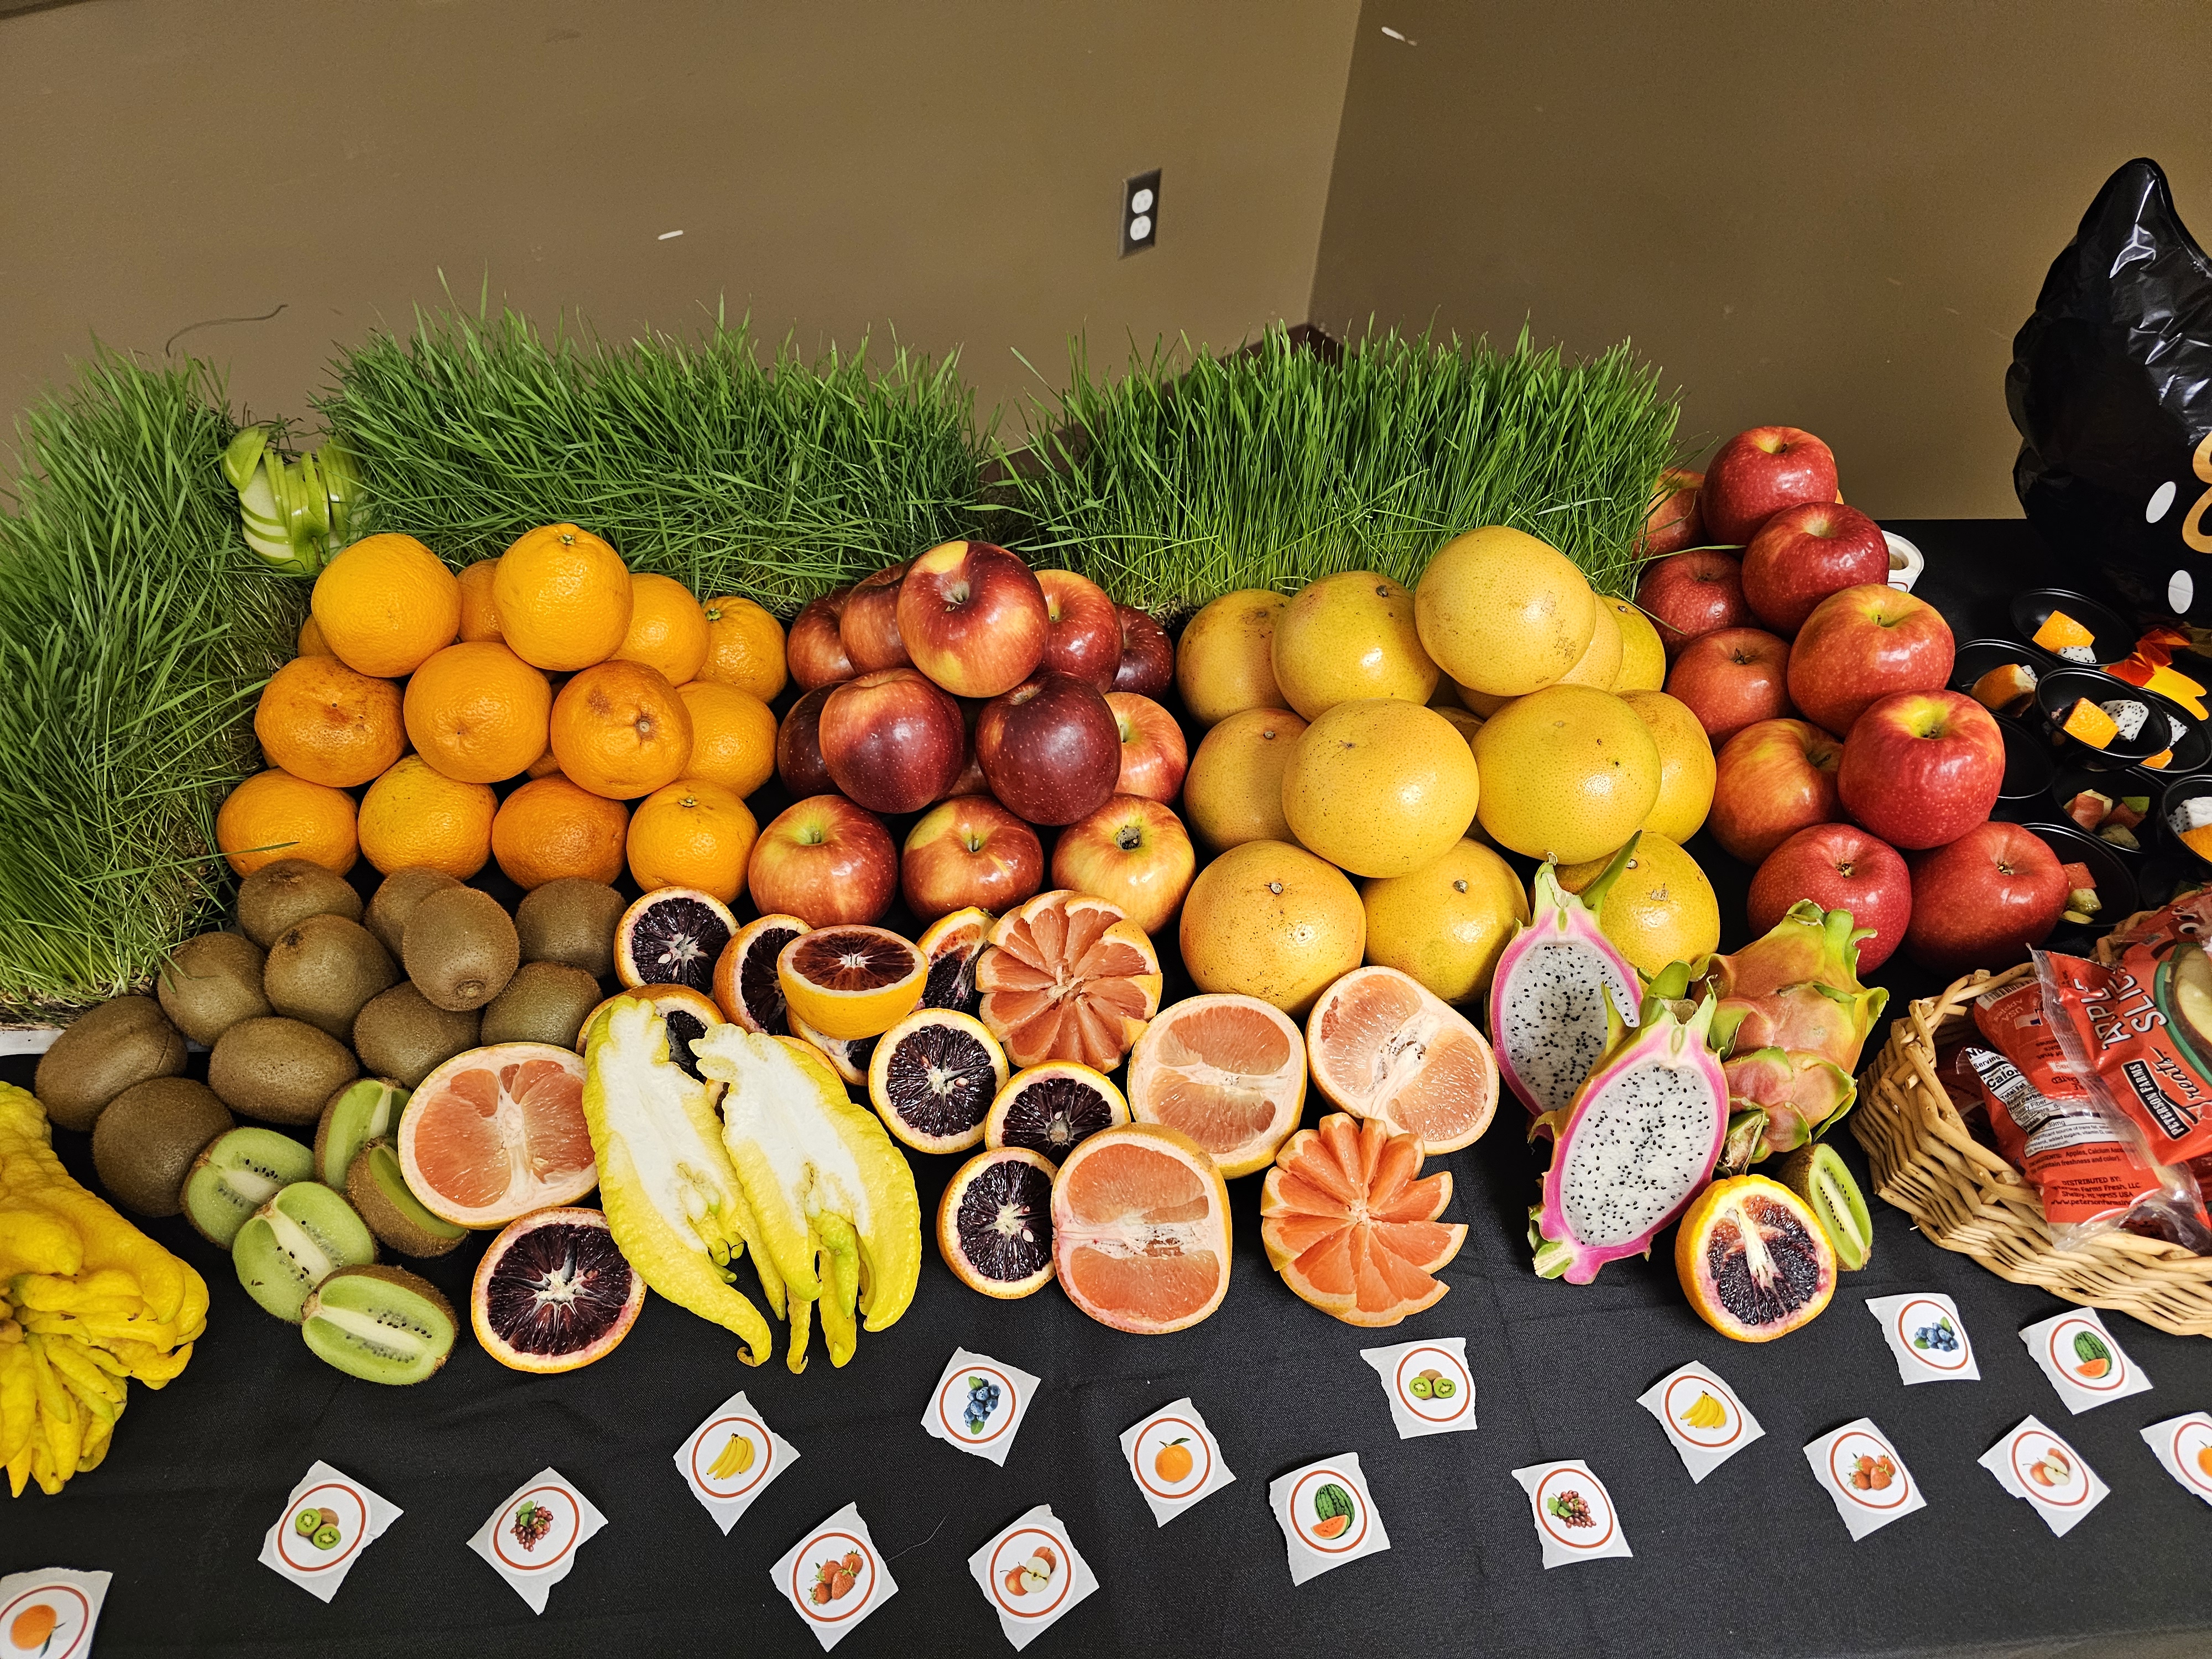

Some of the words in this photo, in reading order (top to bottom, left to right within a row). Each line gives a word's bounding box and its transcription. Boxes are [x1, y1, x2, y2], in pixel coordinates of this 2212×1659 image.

[2107, 968, 2169, 1032] SLIC
[1993, 997, 2023, 1022] Apples
[2001, 1006, 2024, 1021] USA
[1973, 1056, 2001, 1070] Serving
[1983, 1067, 2002, 1081] Amount
[2129, 1064, 2154, 1093] FARMS
[2000, 1088, 2016, 1100] Total
[2015, 1082, 2027, 1092] Fat
[2006, 1092, 2025, 1106] Sodium
[2015, 1105, 2030, 1117] Dietary
[2030, 1099, 2047, 1108] Fiber
[2027, 1107, 2049, 1117] Sugars
[2146, 1093, 2185, 1136] PETERSON
[2023, 1117, 2041, 1131] Protein
[2044, 1140, 2070, 1149] potassium.
[2065, 1150, 2088, 1158] Apples,
[2037, 1161, 2061, 1171] maintain
[2061, 1159, 2091, 1167] freshness
[2061, 1176, 2108, 1186] DISTRIBUTED
[2061, 1191, 2087, 1199] Shelby,
